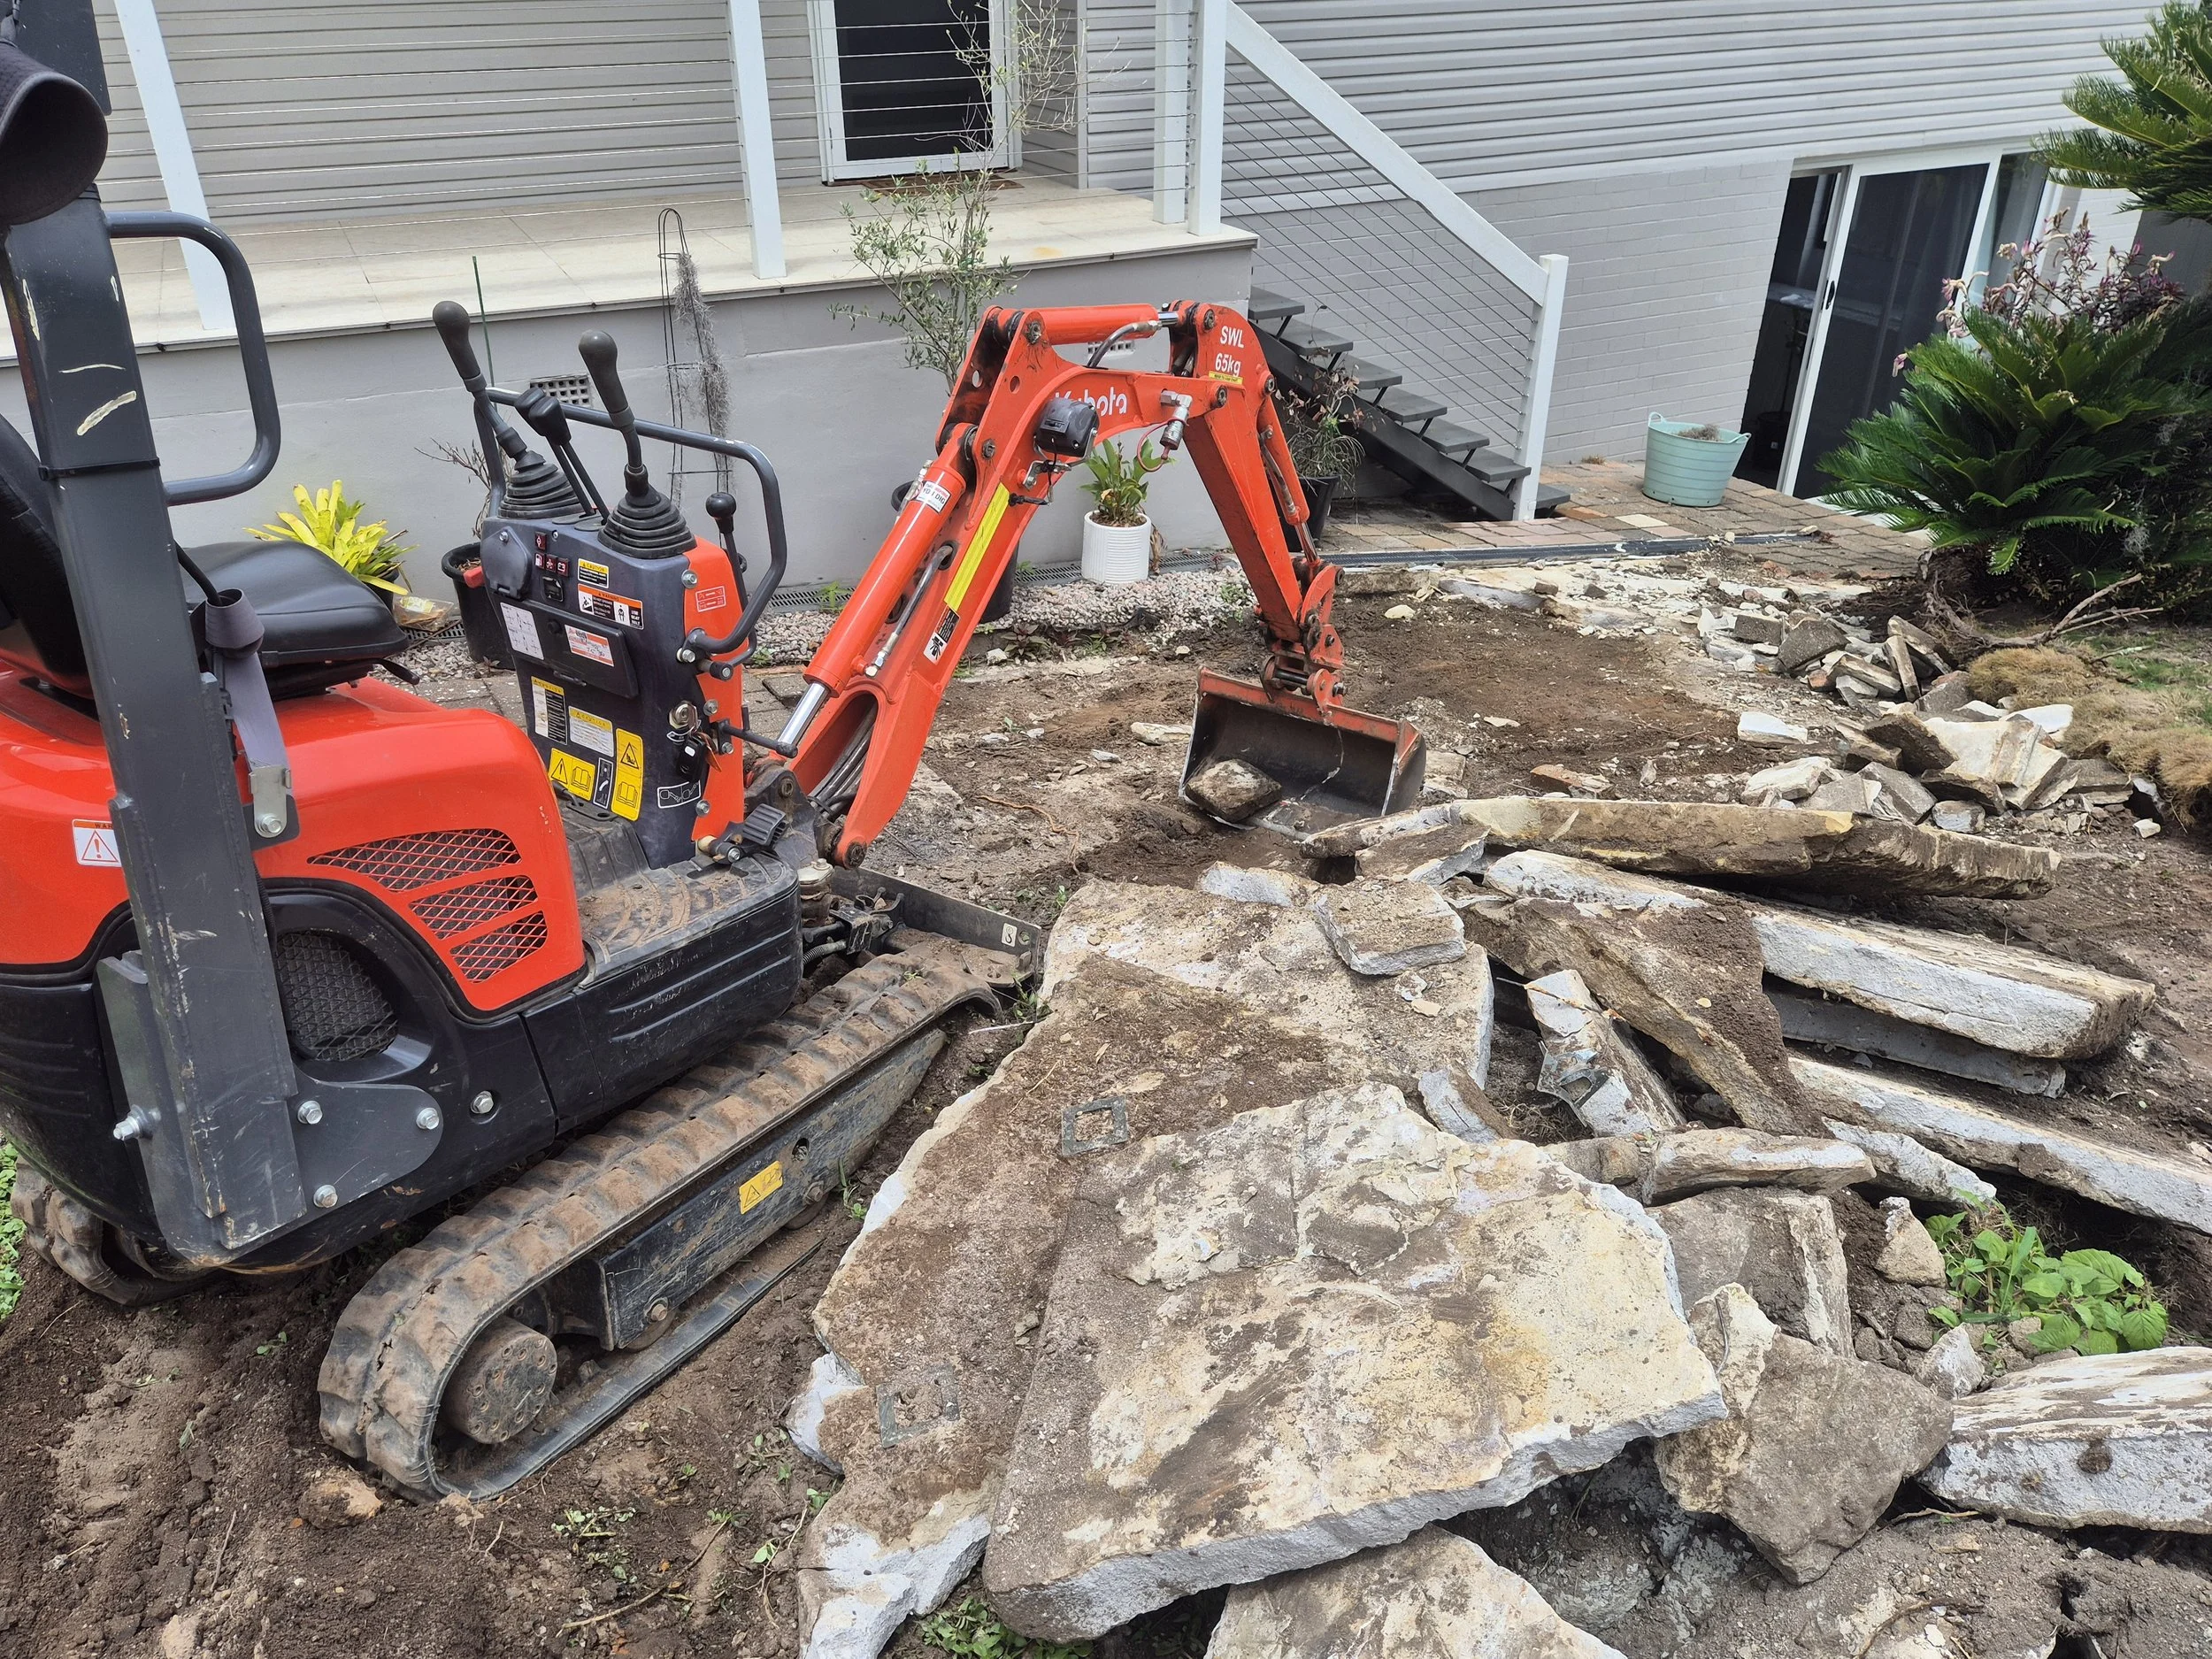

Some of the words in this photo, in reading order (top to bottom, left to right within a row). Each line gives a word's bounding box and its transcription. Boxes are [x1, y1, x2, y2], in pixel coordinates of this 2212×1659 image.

[1220, 326, 1245, 349] SWL
[1215, 353, 1241, 377] 65kg
[1055, 386, 1127, 418] bota
